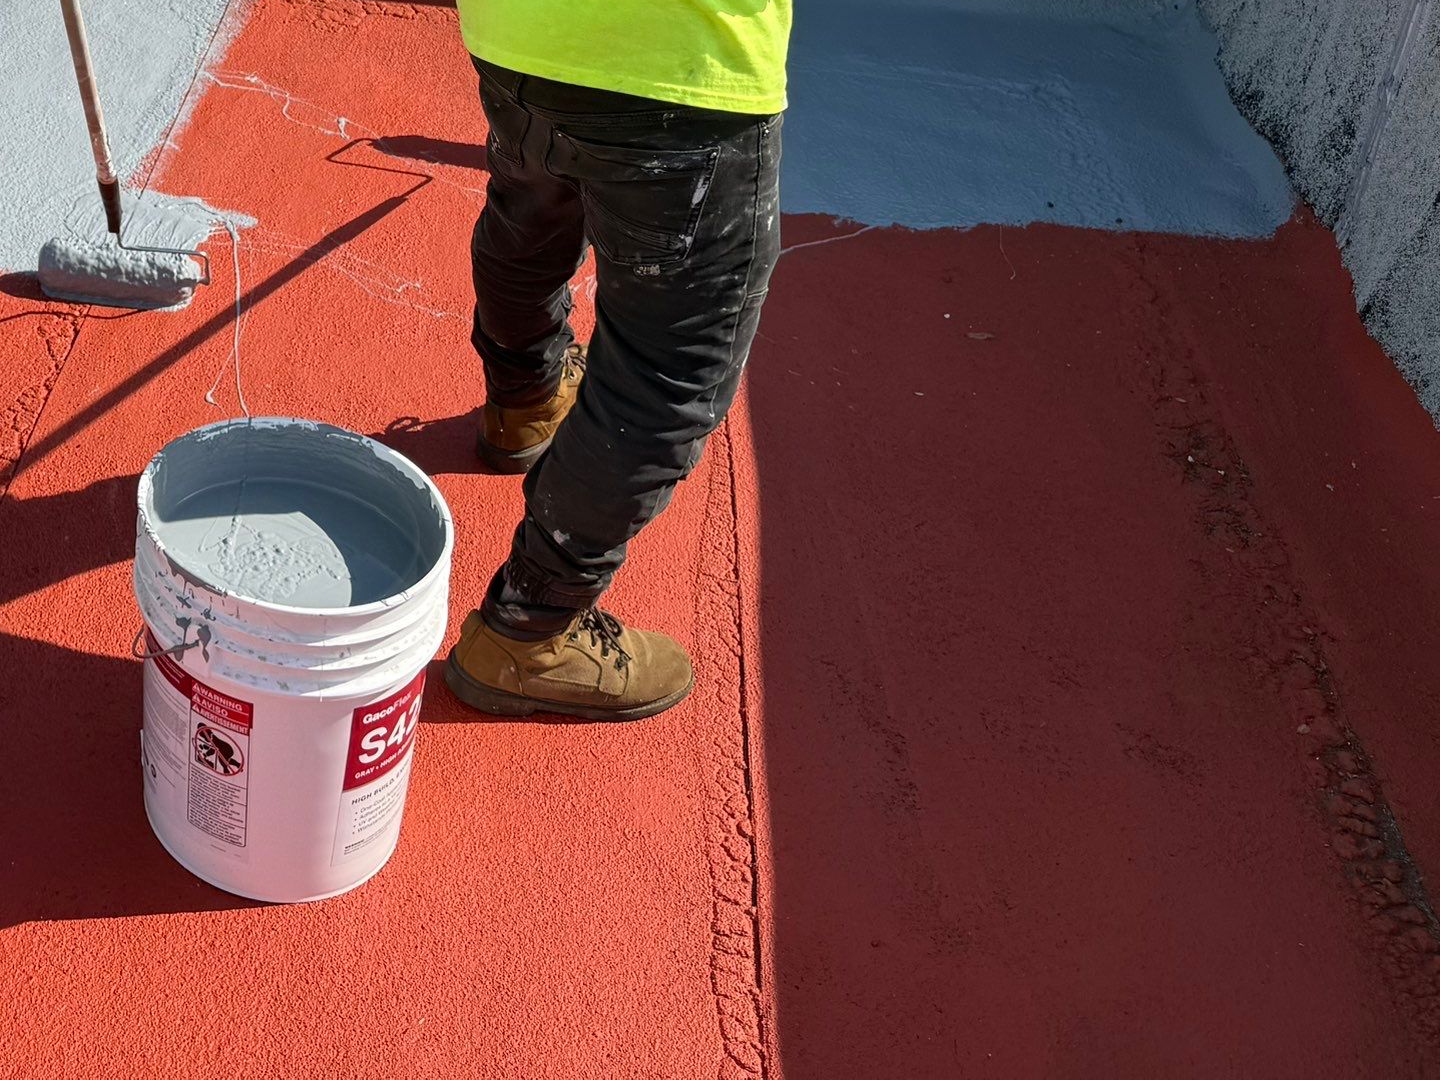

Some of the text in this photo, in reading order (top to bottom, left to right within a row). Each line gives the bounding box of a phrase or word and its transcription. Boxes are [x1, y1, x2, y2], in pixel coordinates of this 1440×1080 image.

[200, 688, 243, 711] WARNING
[201, 699, 228, 718] AVISO
[355, 767, 375, 779] GRAY
[351, 792, 372, 805] HIGH
